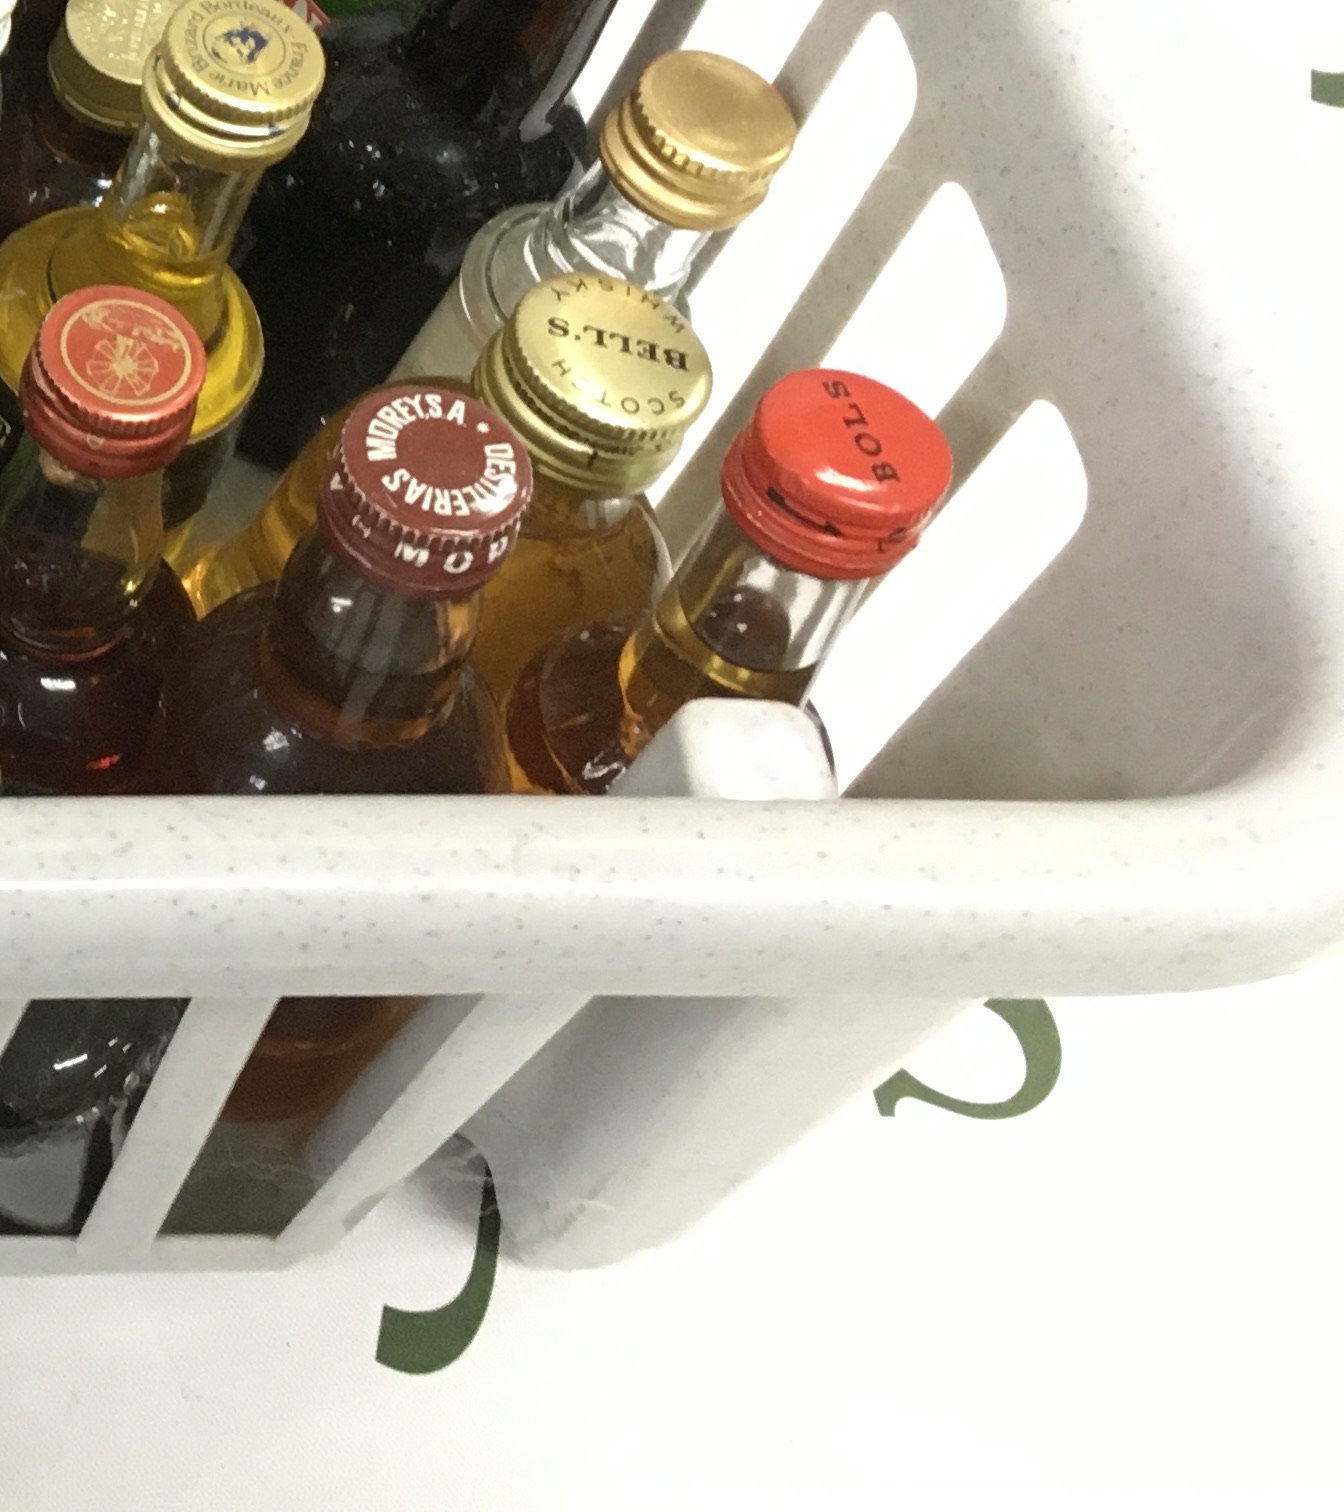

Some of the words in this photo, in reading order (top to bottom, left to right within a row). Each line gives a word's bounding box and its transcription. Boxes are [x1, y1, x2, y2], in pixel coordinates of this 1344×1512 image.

[184, 9, 211, 74] Brizard
[273, 40, 309, 90] France
[208, 71, 271, 97] Marie
[551, 278, 687, 334] WHISKY
[547, 316, 689, 372] BELL'S
[552, 359, 687, 416] SCOTH
[822, 379, 902, 484] BOLS
